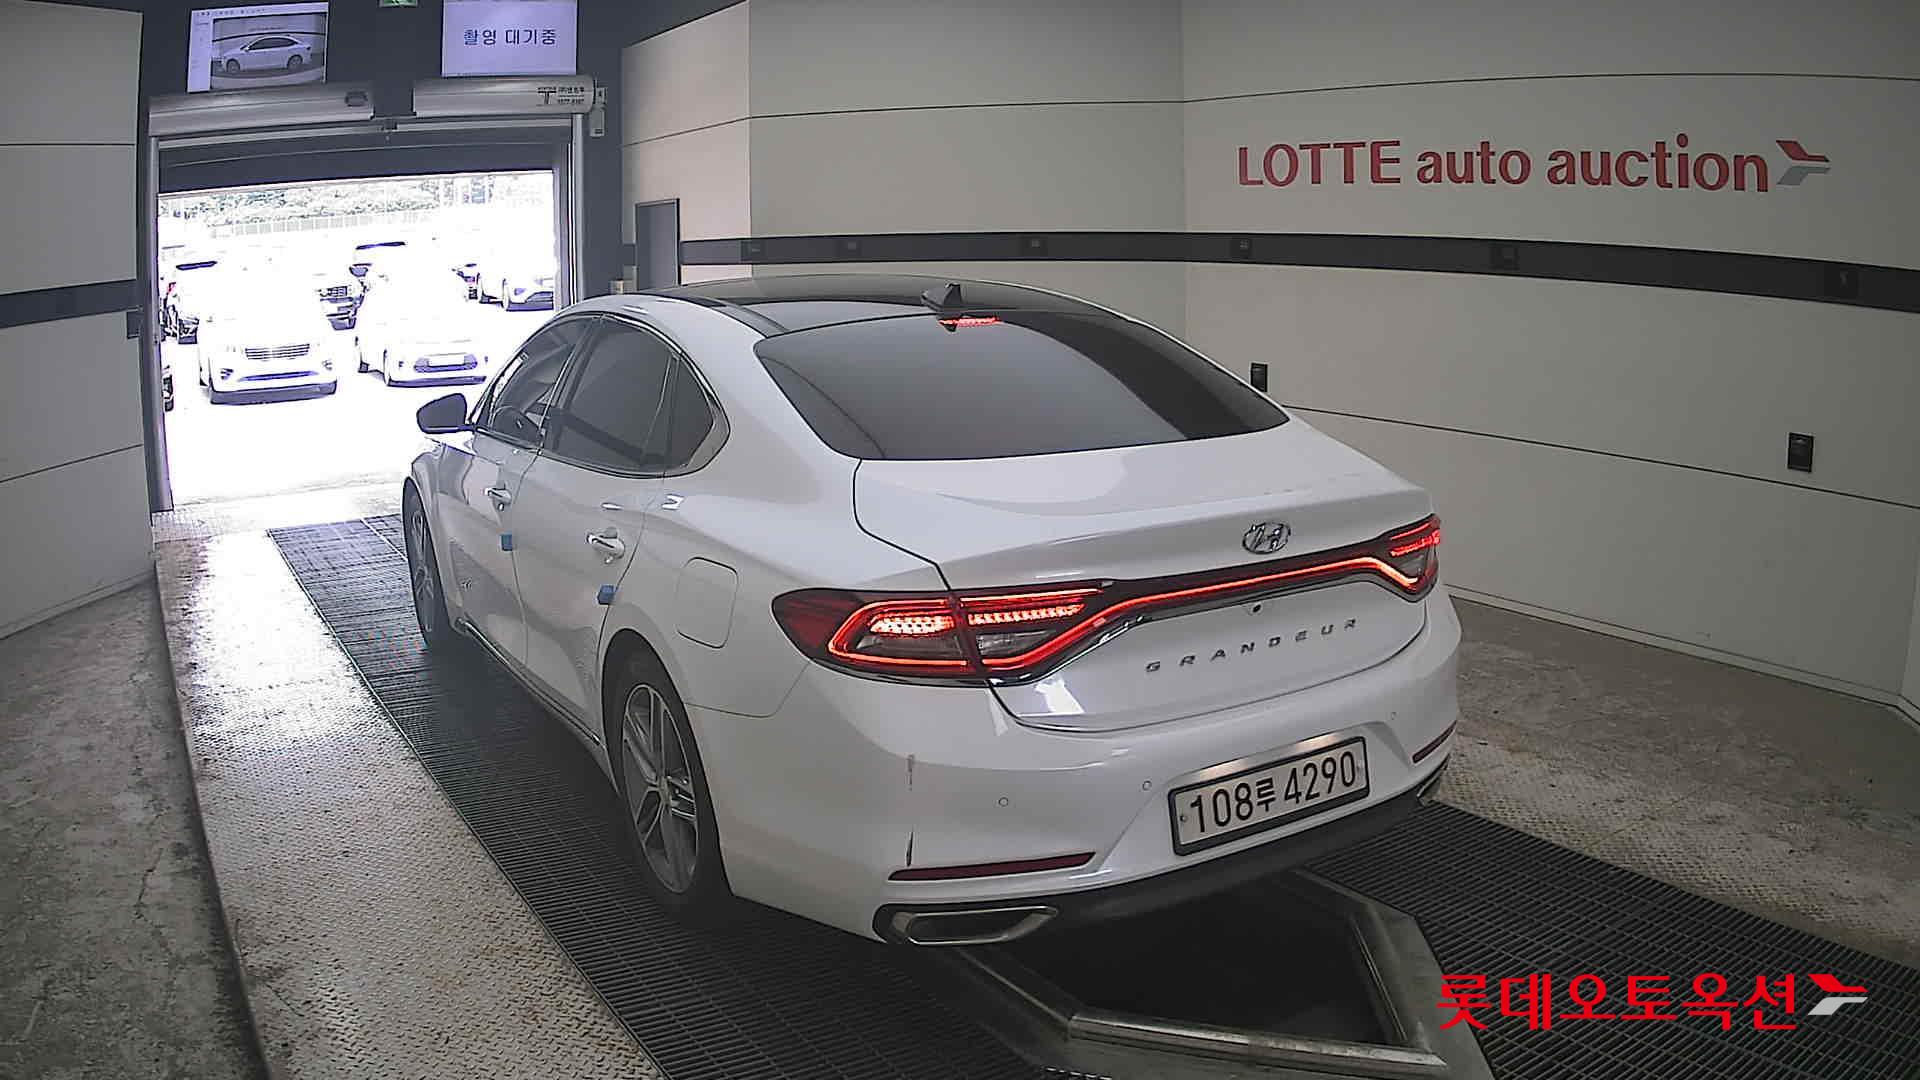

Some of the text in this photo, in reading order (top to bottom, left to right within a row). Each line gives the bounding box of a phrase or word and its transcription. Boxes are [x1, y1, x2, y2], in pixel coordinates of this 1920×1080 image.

[463, 28, 557, 46] 촬영 대기중
[1237, 134, 1770, 193] LOTTE auto auction
[1144, 618, 1357, 673] GRANDEUR
[1283, 750, 1357, 807] 4290
